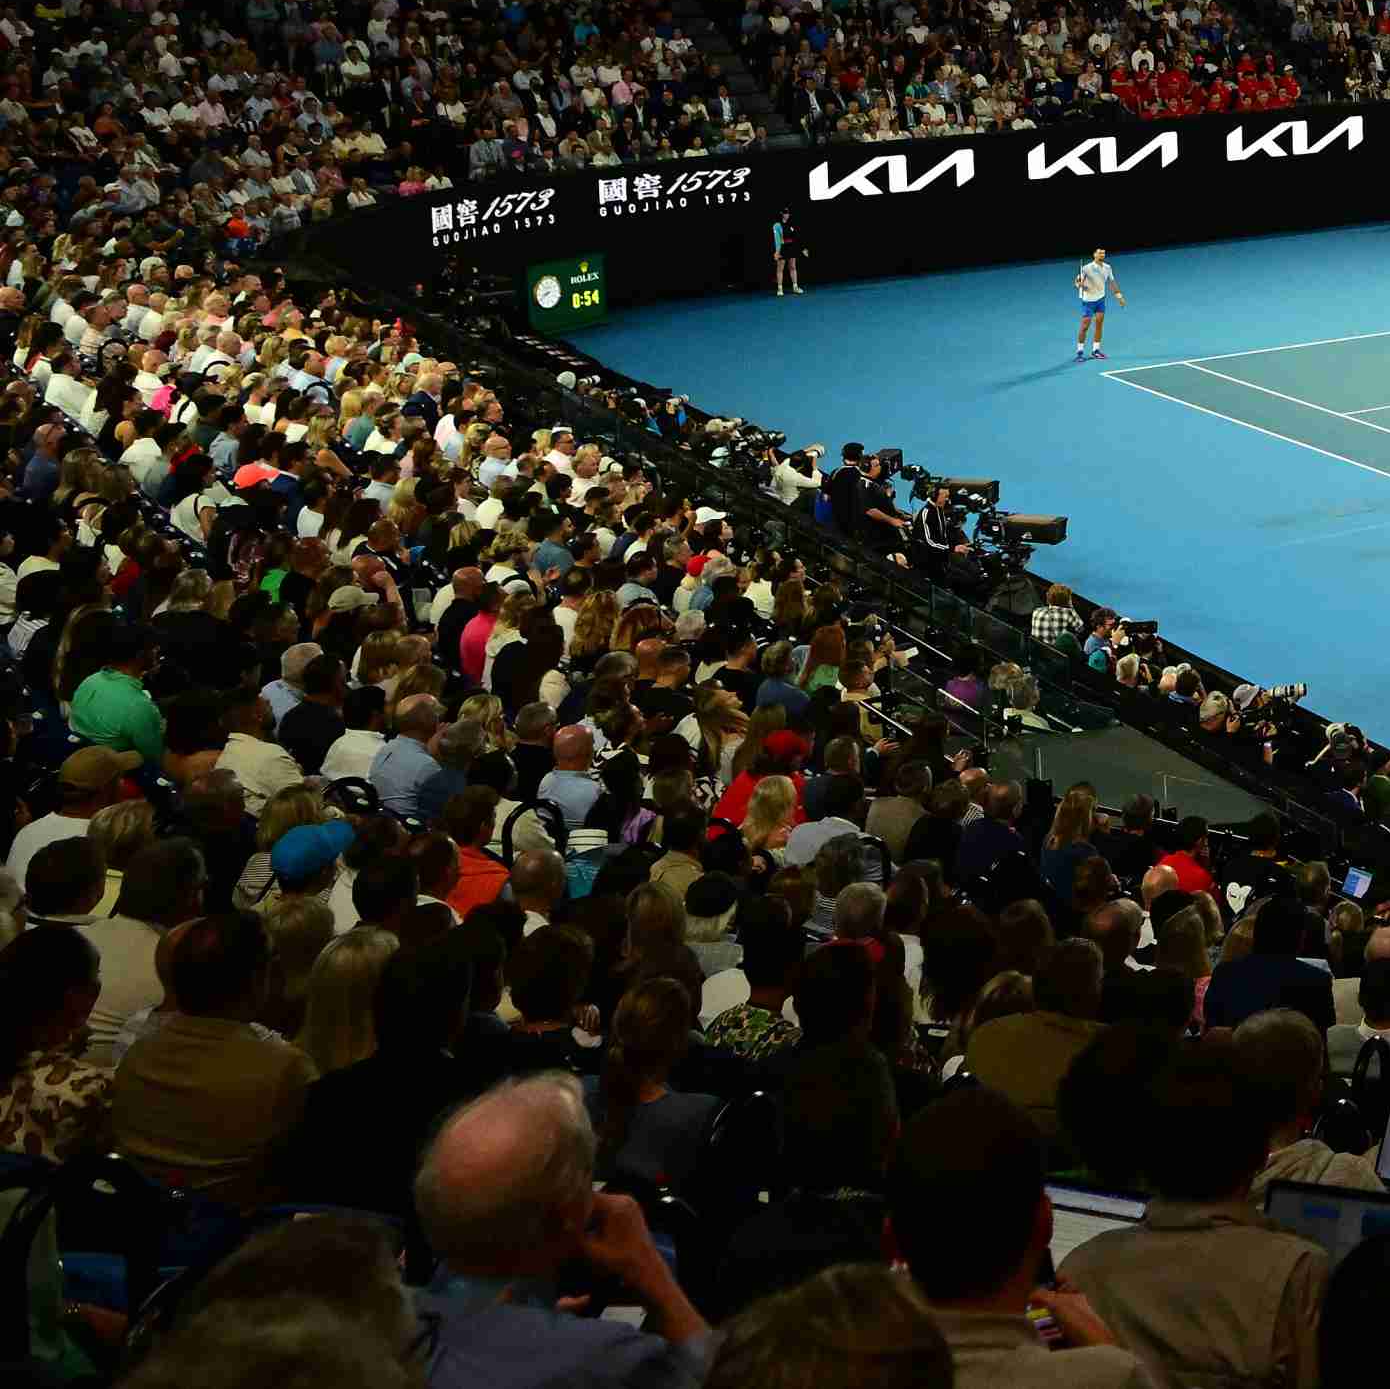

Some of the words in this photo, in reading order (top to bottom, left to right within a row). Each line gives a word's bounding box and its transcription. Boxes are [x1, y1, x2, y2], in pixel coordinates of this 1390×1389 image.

[1227, 116, 1363, 161] KIA
[1028, 132, 1178, 179] KIA
[809, 149, 974, 200] KIA
[600, 198, 686, 216] GUOJIAO
[705, 192, 750, 204] 1573
[433, 223, 500, 247] GUOJIAO
[514, 214, 555, 230] 1573
[571, 271, 599, 284] ROLEX
[573, 290, 599, 308] 0:54
